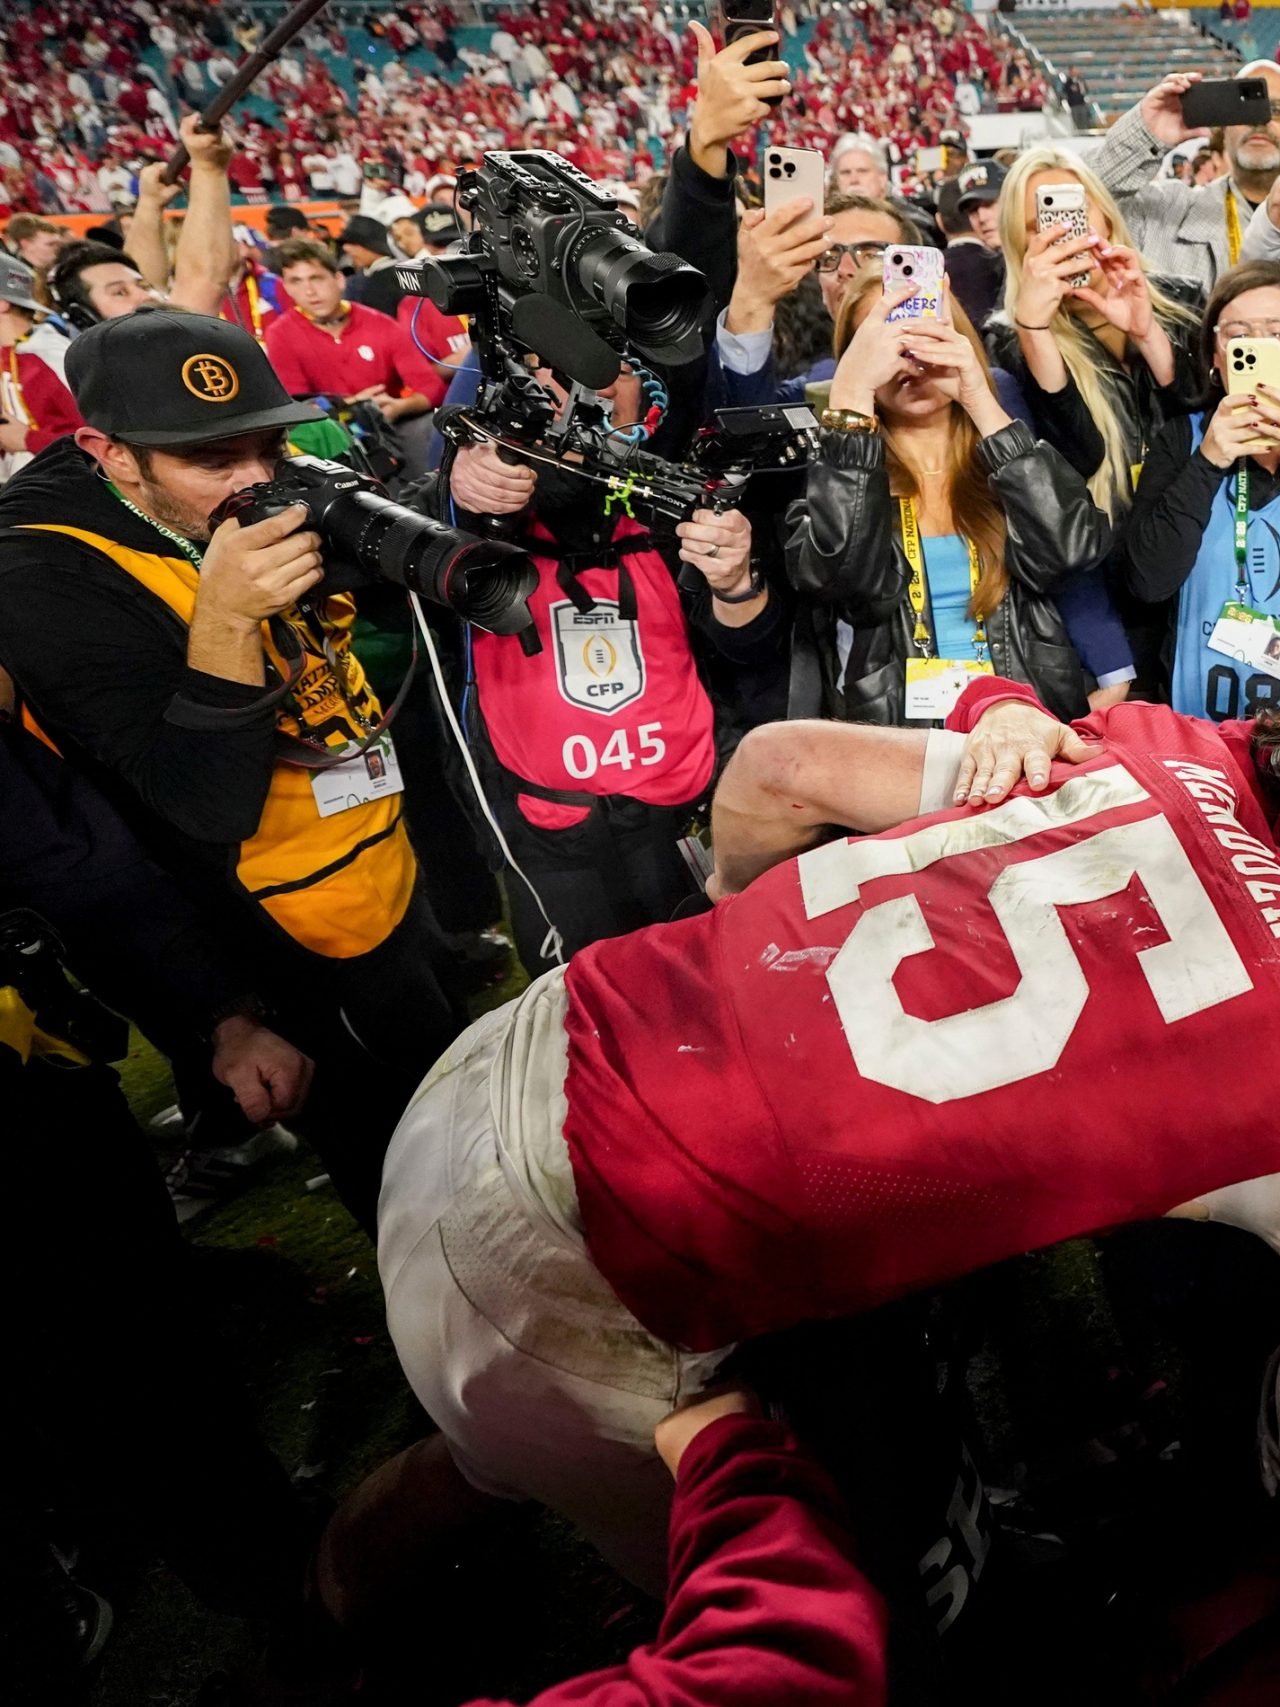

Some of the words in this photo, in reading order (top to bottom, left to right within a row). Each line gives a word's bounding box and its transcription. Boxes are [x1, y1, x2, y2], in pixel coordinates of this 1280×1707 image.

[334, 480, 360, 490] Canon
[660, 495, 687, 509] SONY
[1237, 493, 1247, 513] CFP
[902, 496, 915, 539] NATIONA
[120, 499, 204, 569] HAMPIONSHIP
[906, 540, 917, 560] CFP
[573, 612, 615, 625] ESPN
[586, 682, 625, 697] CFP
[562, 721, 667, 780] 045
[797, 763, 1255, 1105] 15
